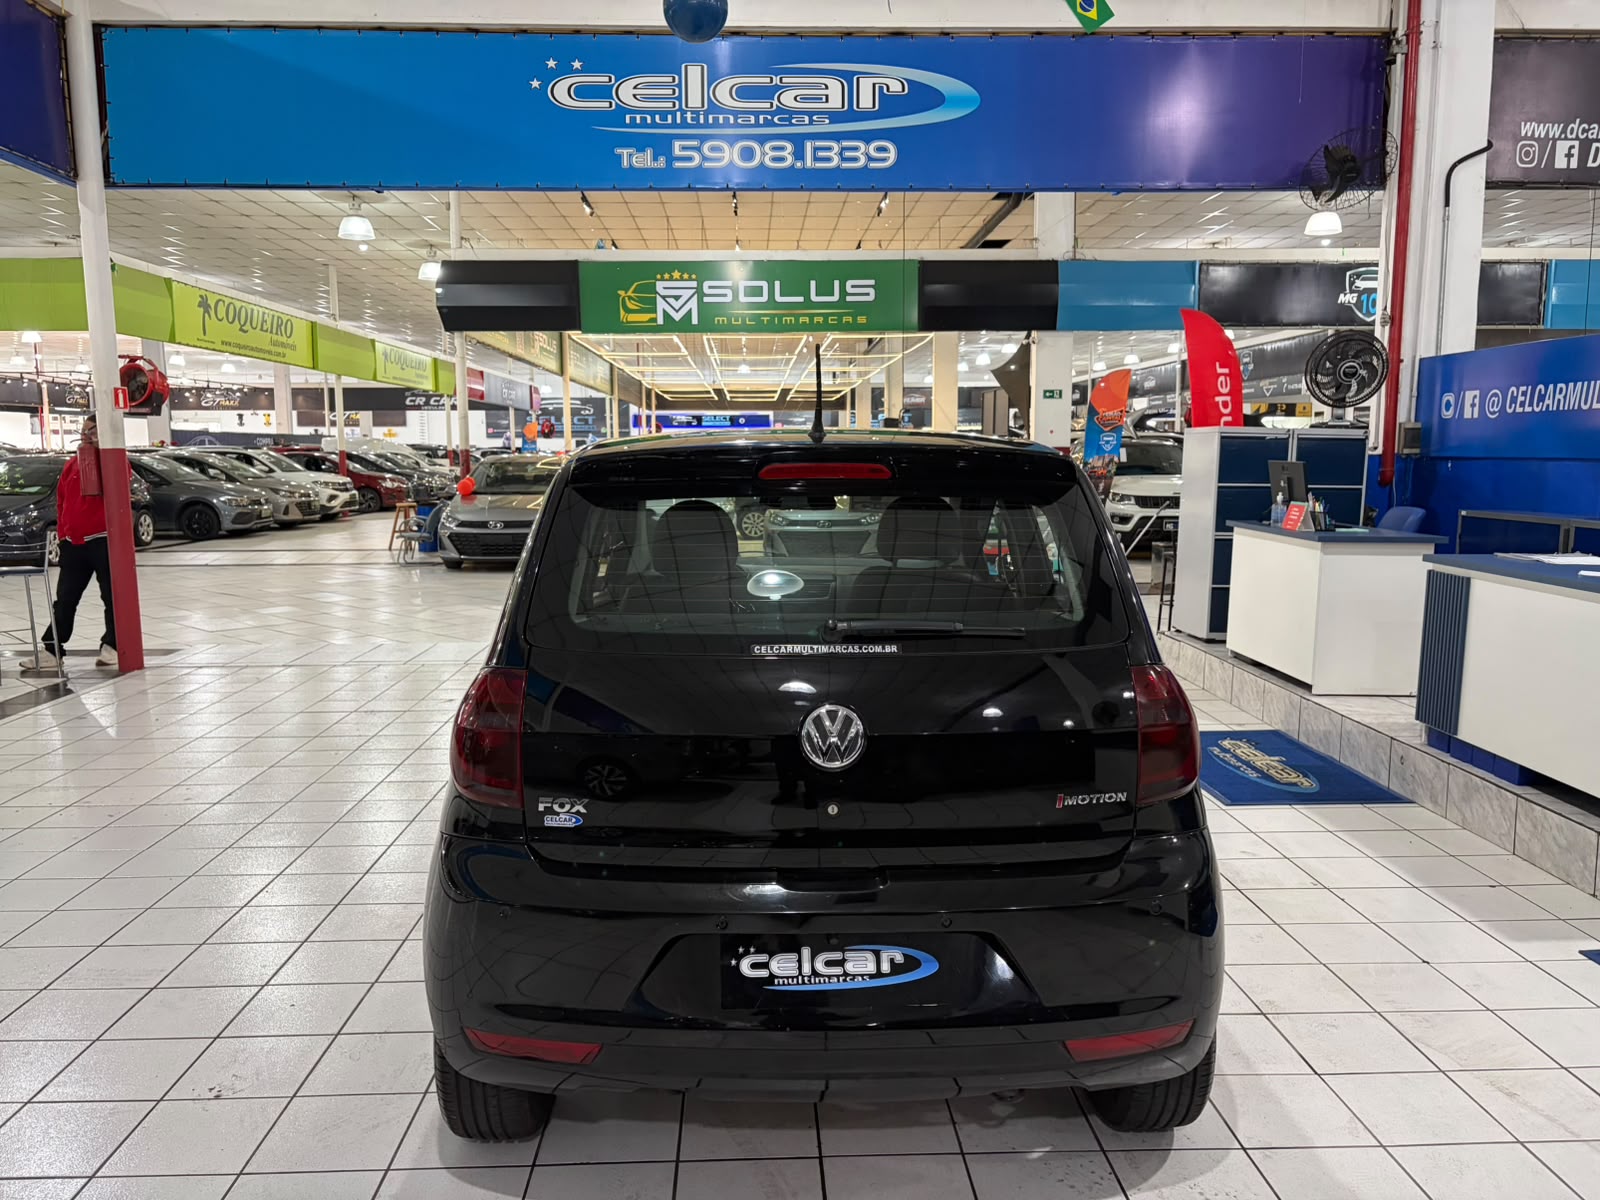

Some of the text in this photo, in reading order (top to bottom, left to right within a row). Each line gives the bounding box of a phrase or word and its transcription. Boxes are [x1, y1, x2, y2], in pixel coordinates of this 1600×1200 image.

[548, 63, 909, 111] celcar
[625, 112, 830, 126] multimarcas
[614, 139, 898, 169] Tel.: 5908.1339
[702, 279, 876, 303] SOLUS
[213, 298, 294, 339] COQUEIRO
[714, 316, 868, 325] MULTIMARCAS
[754, 645, 898, 654] CELCARMULTIMARCAS.COM.BR
[538, 797, 589, 813] FOX
[739, 946, 905, 977] celcar
[774, 975, 870, 986] multimarcas
